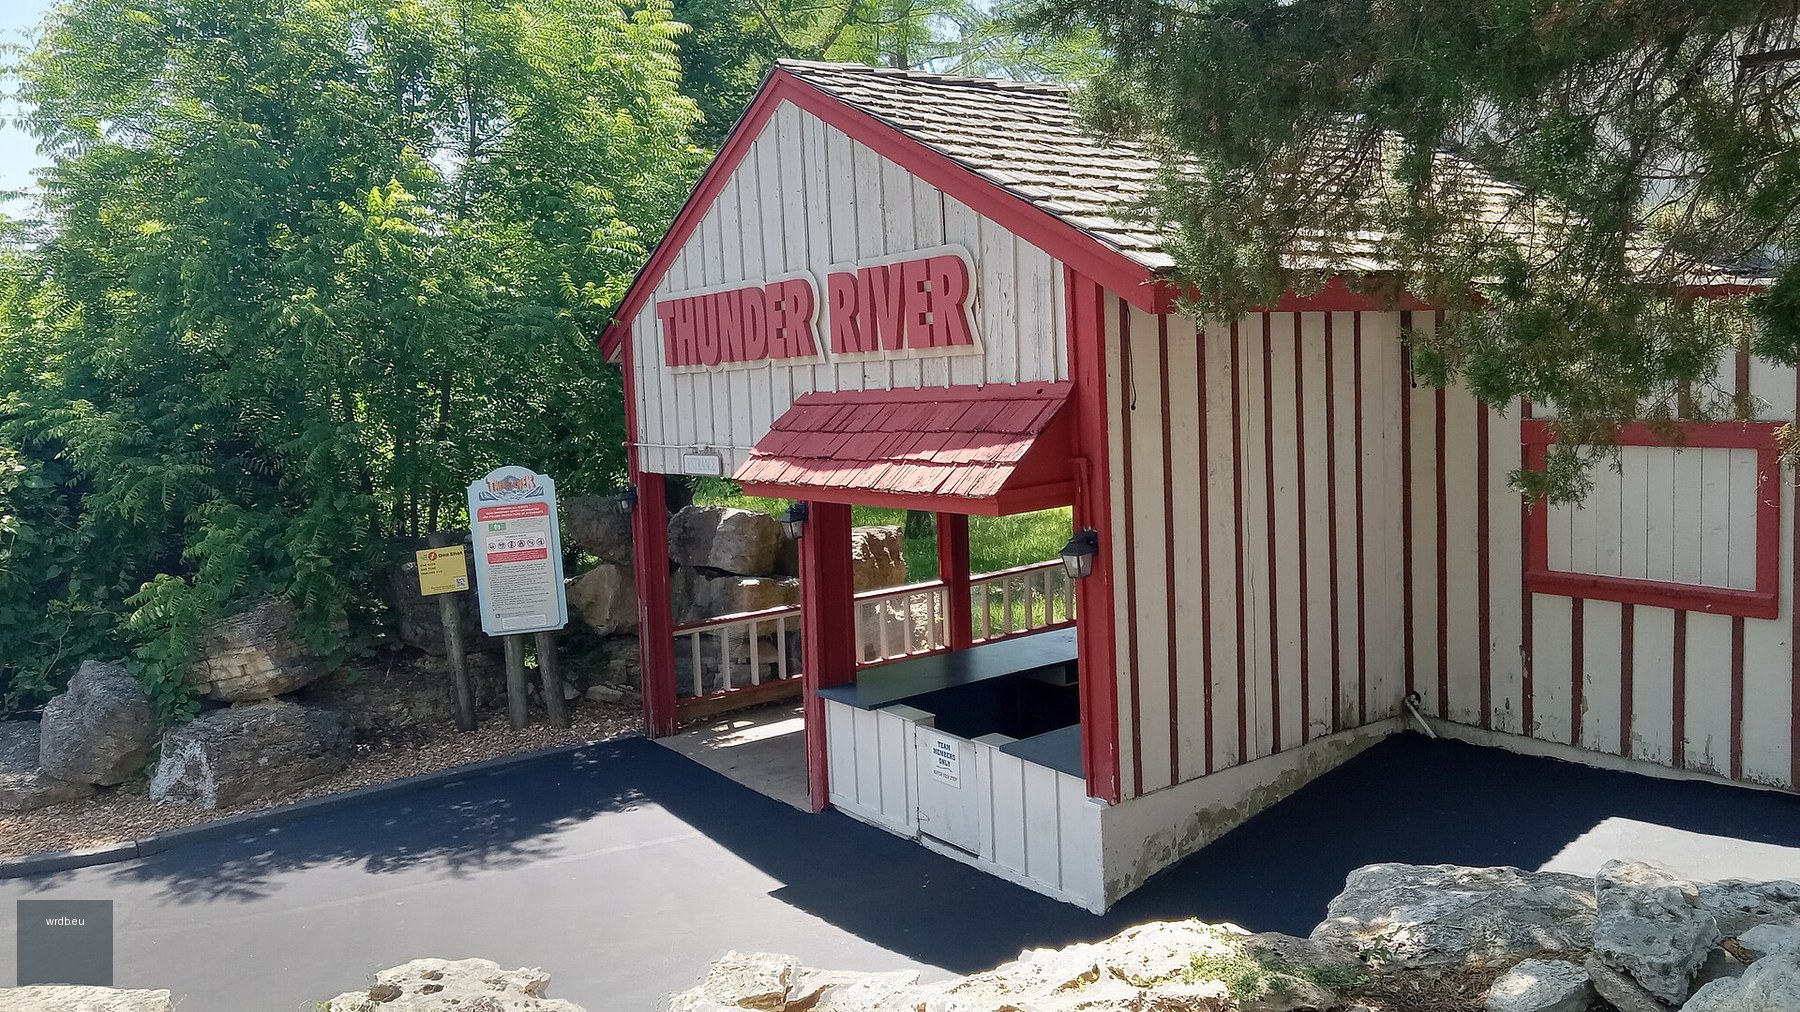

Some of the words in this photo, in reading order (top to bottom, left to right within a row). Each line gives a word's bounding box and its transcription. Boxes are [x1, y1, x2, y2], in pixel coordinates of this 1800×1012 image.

[657, 278, 818, 367] THUNDER
[828, 255, 974, 354] RIVER
[937, 741, 950, 751] TEAM
[932, 748, 956, 761] MEMBERS
[939, 757, 950, 767] ONLY
